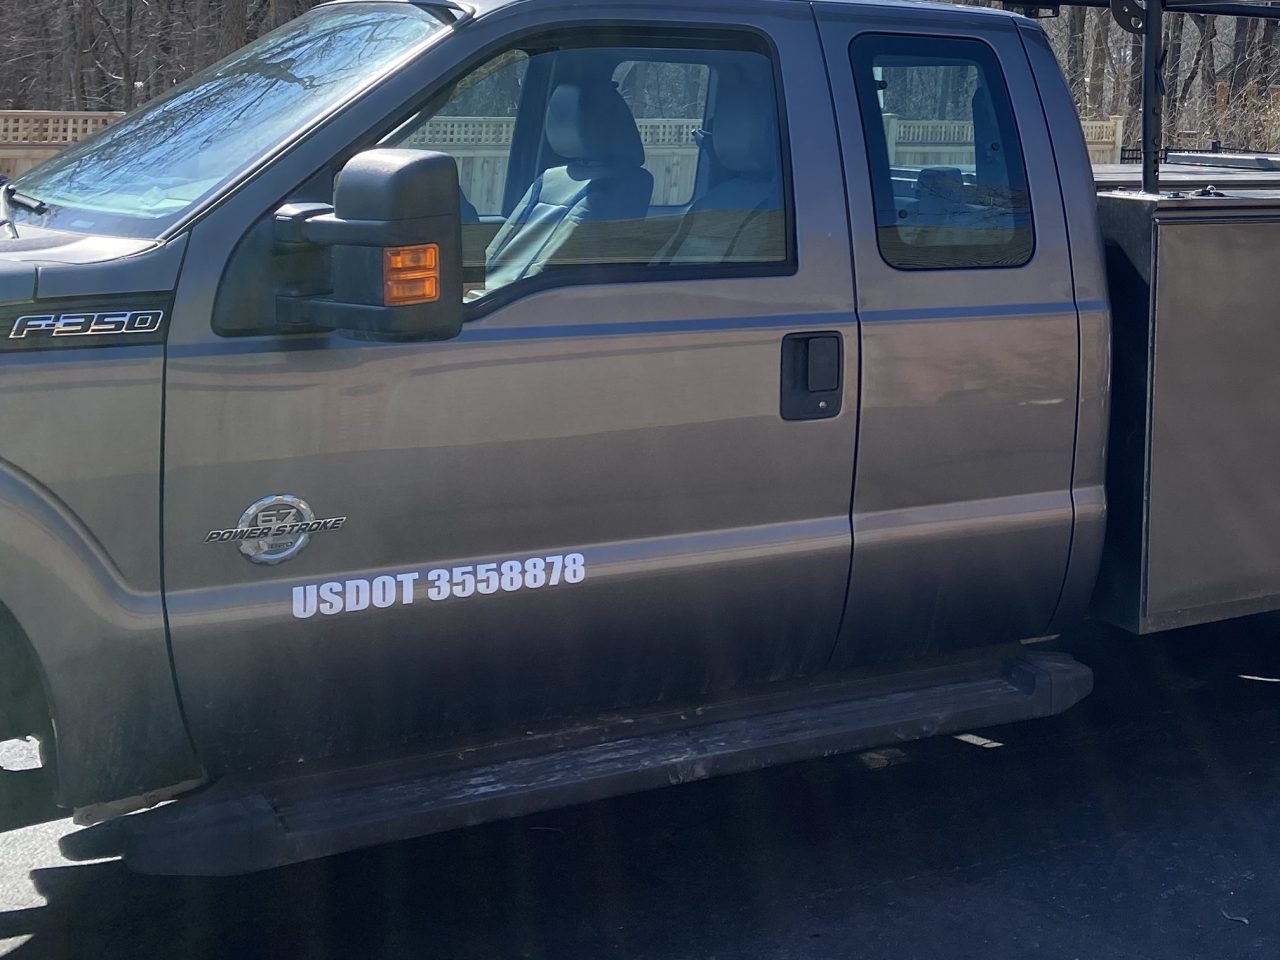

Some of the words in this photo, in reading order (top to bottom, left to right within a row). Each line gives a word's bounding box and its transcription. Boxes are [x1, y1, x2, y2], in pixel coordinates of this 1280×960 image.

[8, 310, 164, 339] F-350
[204, 526, 272, 544] POWER
[272, 517, 347, 537] STROKE
[292, 572, 419, 619] USDOT
[427, 553, 586, 601] 3558878
